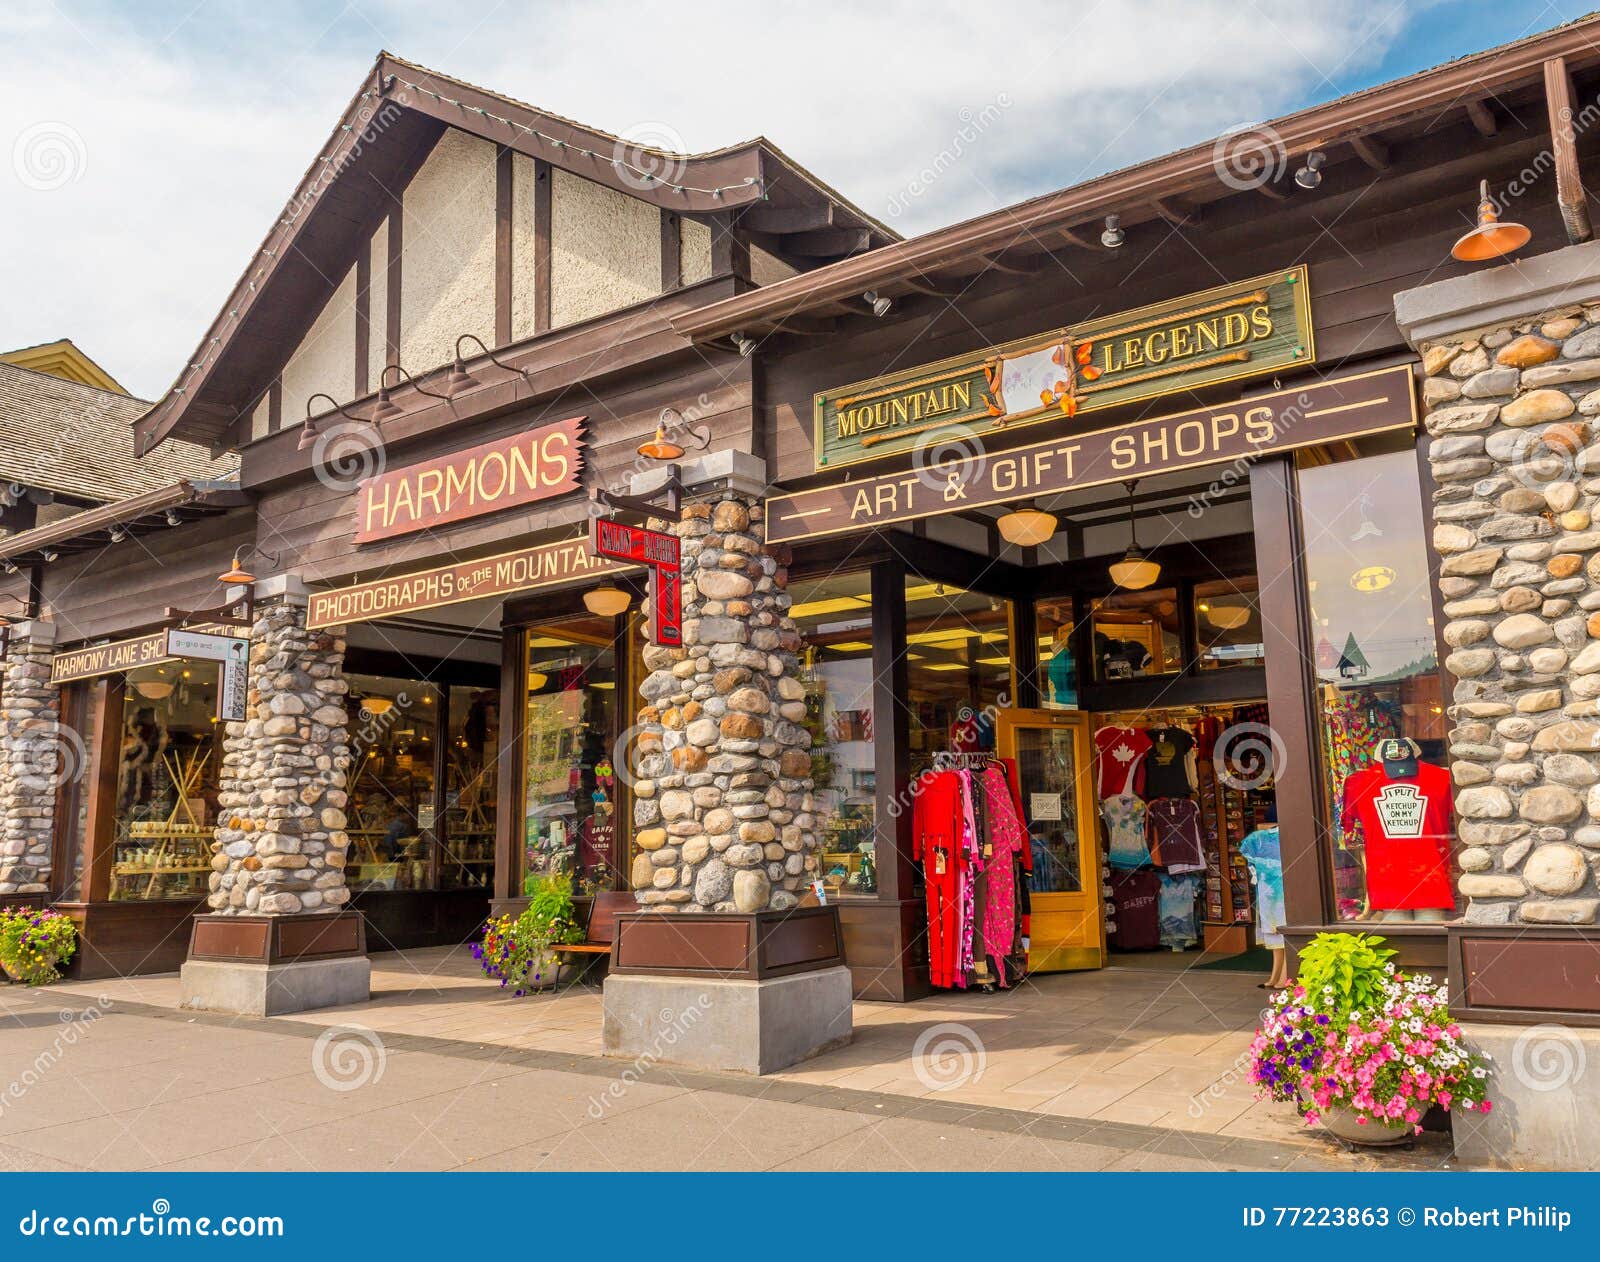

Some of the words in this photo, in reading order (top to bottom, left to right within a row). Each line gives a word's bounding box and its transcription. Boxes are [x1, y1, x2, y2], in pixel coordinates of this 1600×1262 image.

[836, 380, 972, 439] MOUNTAIN
[1103, 305, 1274, 374] LEGENDS
[365, 432, 570, 531] HARMONS
[850, 479, 919, 520] ART
[943, 472, 967, 502] &
[991, 445, 1081, 493] GIFT
[1111, 406, 1275, 470] SHOPS
[315, 573, 453, 621] PHOTOGRAPHS
[472, 566, 492, 582] THE
[55, 651, 106, 677] HARMONY
[108, 644, 138, 667] LANE
[1386, 802, 1417, 810] KETCHUP
[1391, 810, 1400, 818] ON
[1402, 810, 1413, 818] MY
[1394, 788, 1412, 797] PUT
